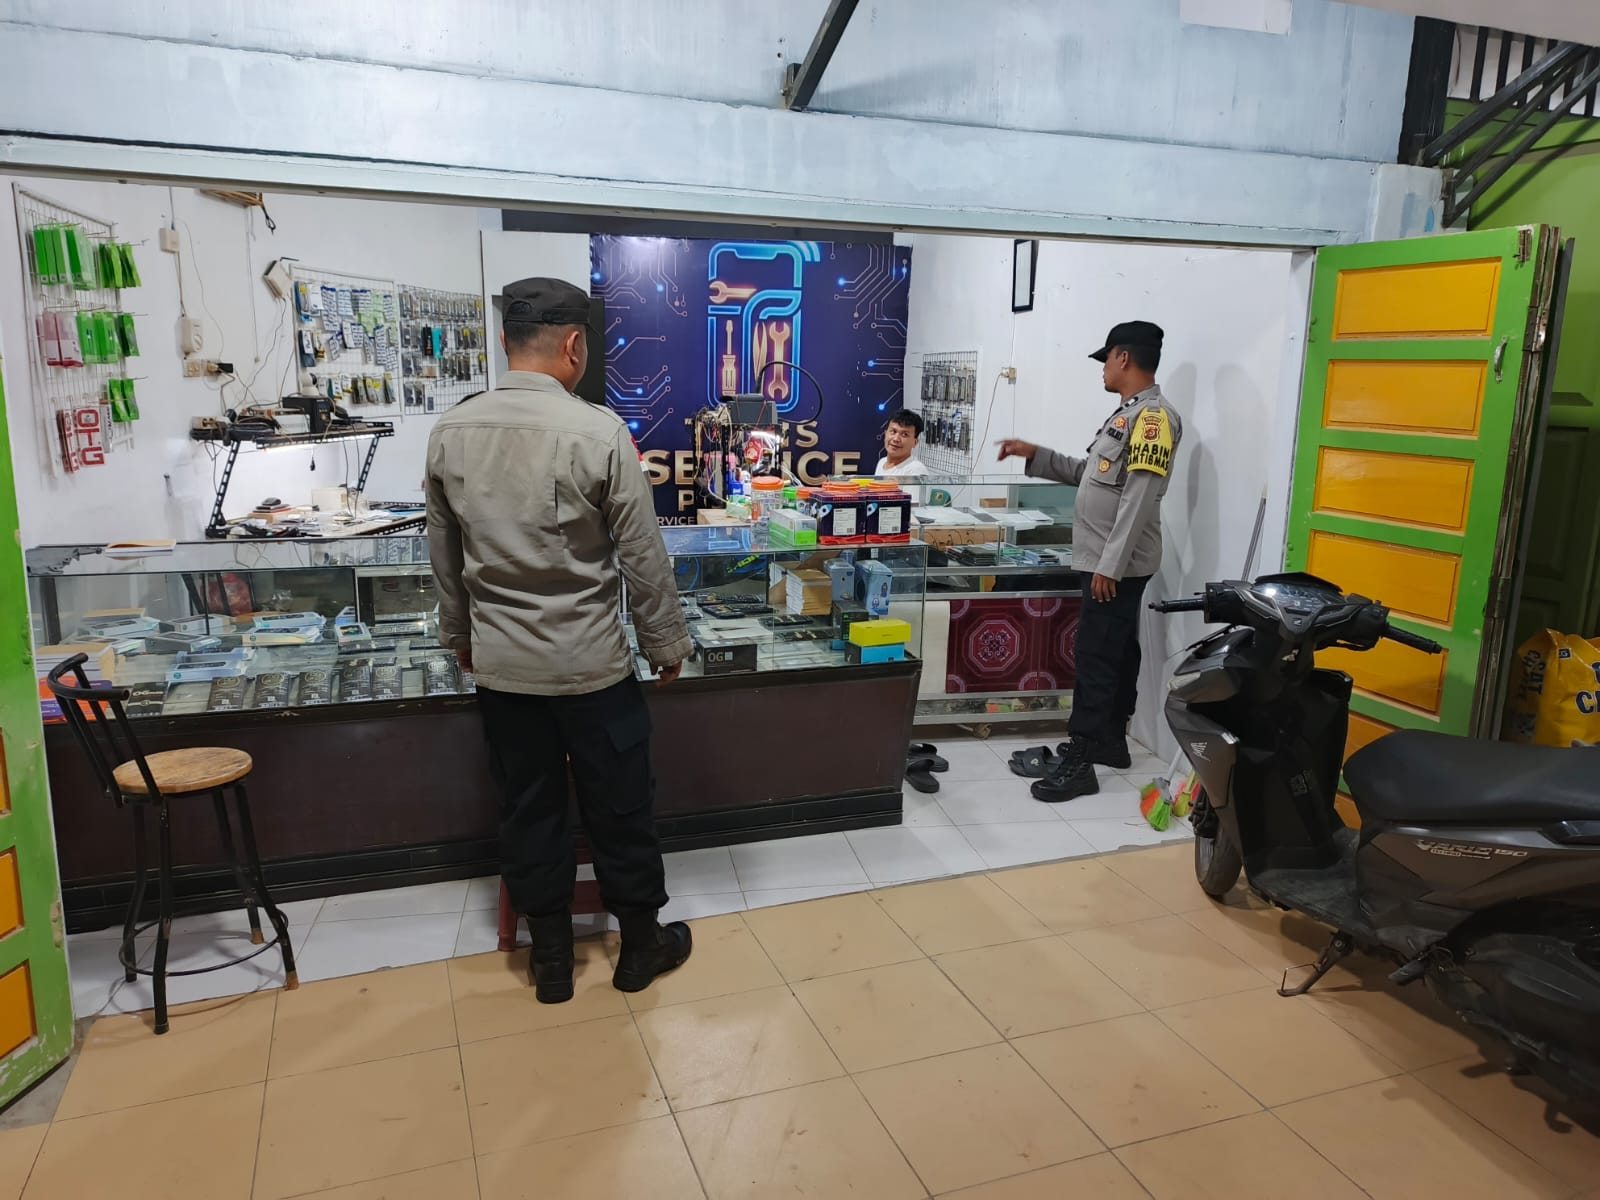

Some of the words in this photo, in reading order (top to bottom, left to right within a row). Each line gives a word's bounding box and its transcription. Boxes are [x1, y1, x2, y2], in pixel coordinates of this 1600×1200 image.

[77, 409, 104, 465] OTG
[642, 449, 860, 486] SEICE
[656, 516, 696, 526] RVICE
